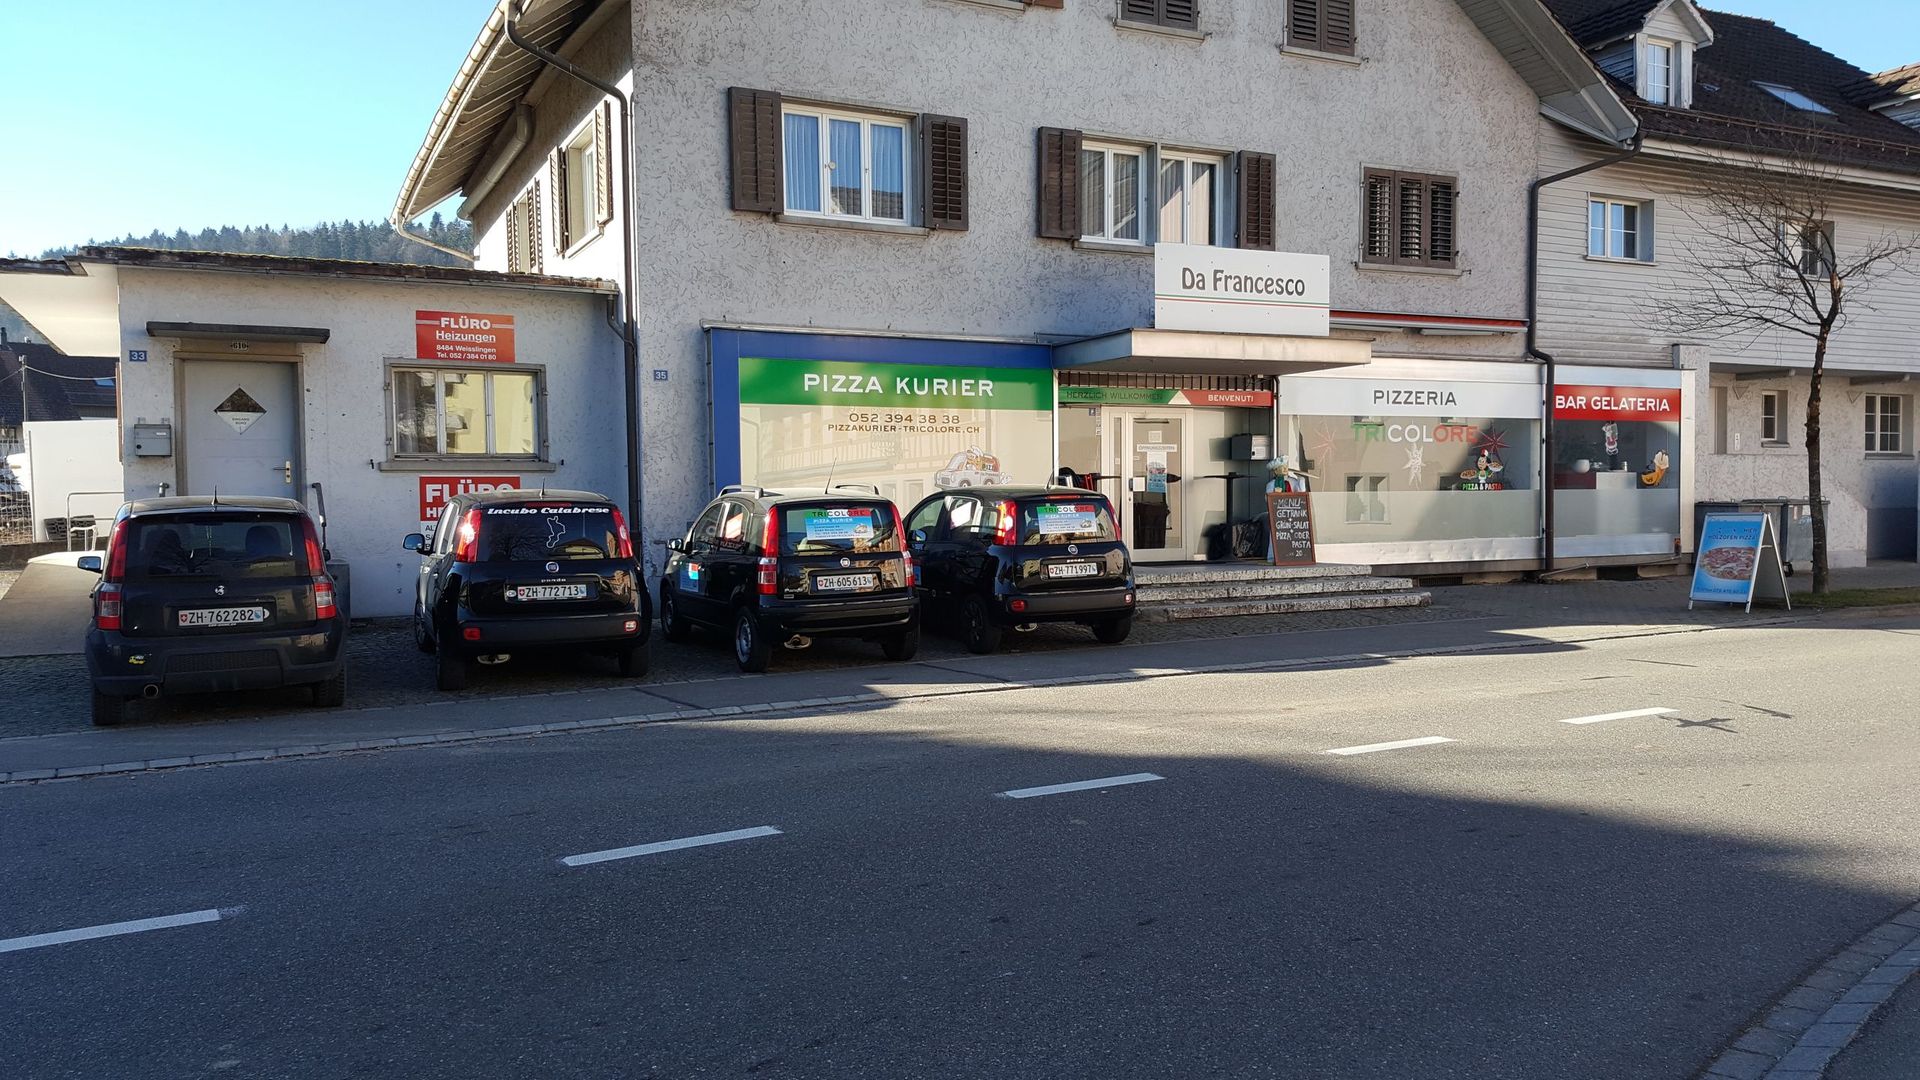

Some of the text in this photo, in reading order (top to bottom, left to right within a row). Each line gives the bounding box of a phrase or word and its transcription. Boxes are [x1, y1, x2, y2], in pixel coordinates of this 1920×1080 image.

[1182, 267, 1305, 297] Da Francesco
[440, 316, 492, 330] FLÜRO
[436, 331, 497, 343] Heizungen
[455, 345, 497, 353] Weisslingen
[131, 352, 146, 360] 33
[655, 371, 667, 380] 35
[804, 373, 994, 397] PIZZA KURIER
[1066, 391, 1163, 401] HERZLICH WILLKOMMEN
[1208, 394, 1254, 403] BENVENUTI
[1372, 389, 1457, 407] PIZZERIA
[1556, 394, 1670, 413] BAR GELATERIA
[849, 413, 960, 424] 052 394 38 38
[828, 423, 980, 435] PIZZAKURIER-TRICOLORE.CH
[1352, 424, 1480, 443] TRICOLORE
[1462, 483, 1479, 491] PIZZA
[487, 506, 610, 515] Incubo Calabrese
[811, 509, 866, 518] TRICOLORE
[1044, 505, 1091, 513] TRICOLORE
[1276, 531, 1310, 540] PIZZA ODER
[1291, 540, 1312, 549] PASTA
